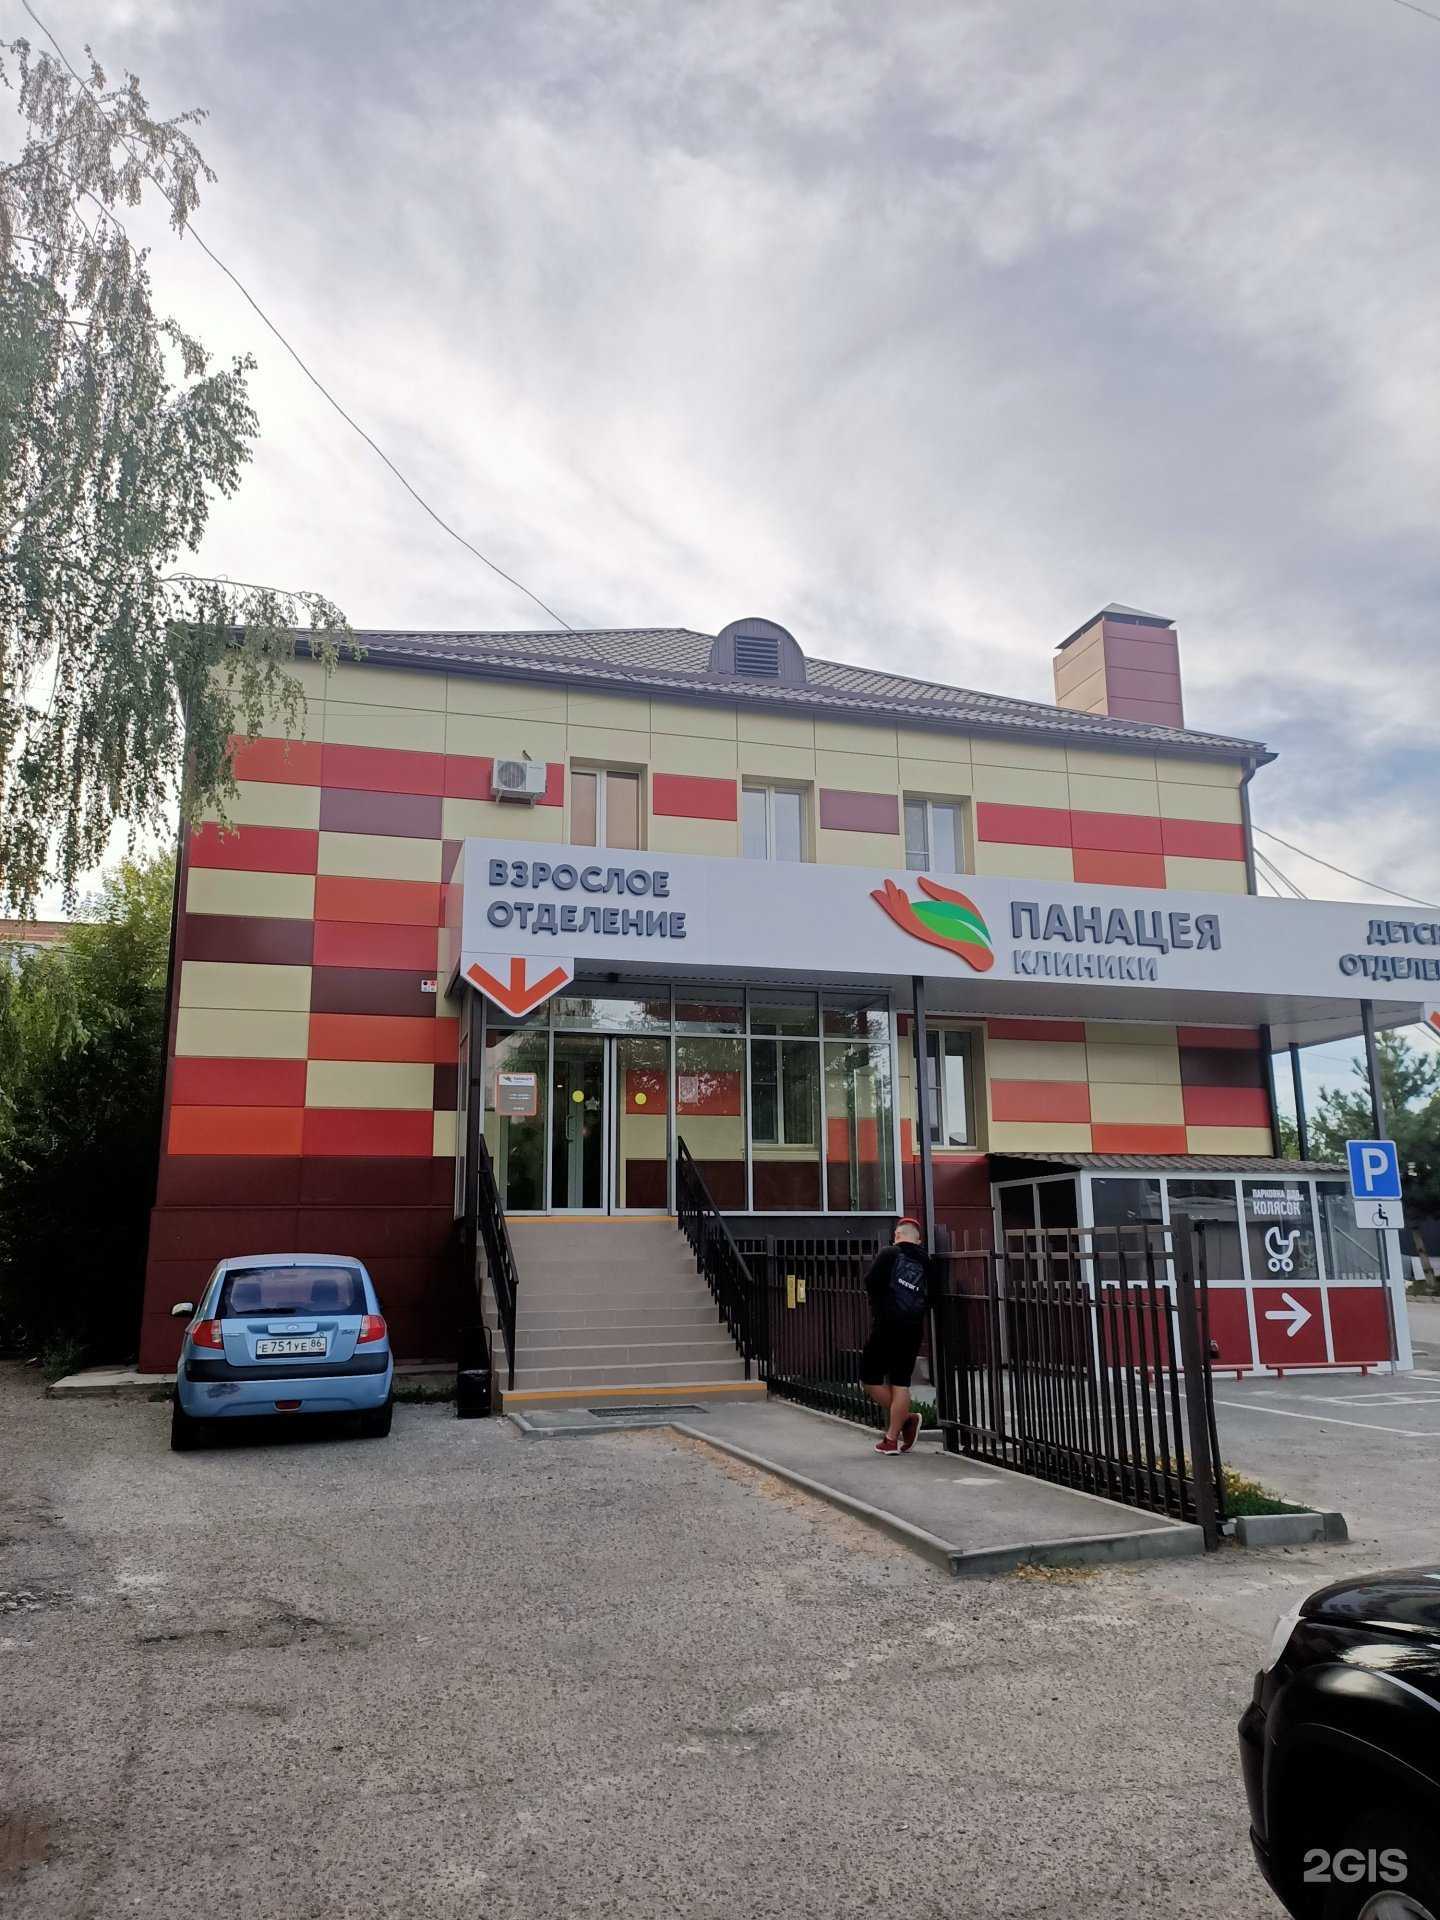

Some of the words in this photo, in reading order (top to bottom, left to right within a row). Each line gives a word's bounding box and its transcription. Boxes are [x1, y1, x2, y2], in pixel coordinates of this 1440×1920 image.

[488, 858, 670, 897] ВЗРОСЛОЕ
[487, 900, 687, 938] ОТДЕЛЕНИЕ
[1011, 901, 1222, 954] ПАНАЦЕЯ
[1014, 950, 1159, 981] КЛИНИКИ
[1339, 953, 1440, 981] ОТДЕЛЕ
[1253, 1201, 1301, 1216] КОЛЯСОК
